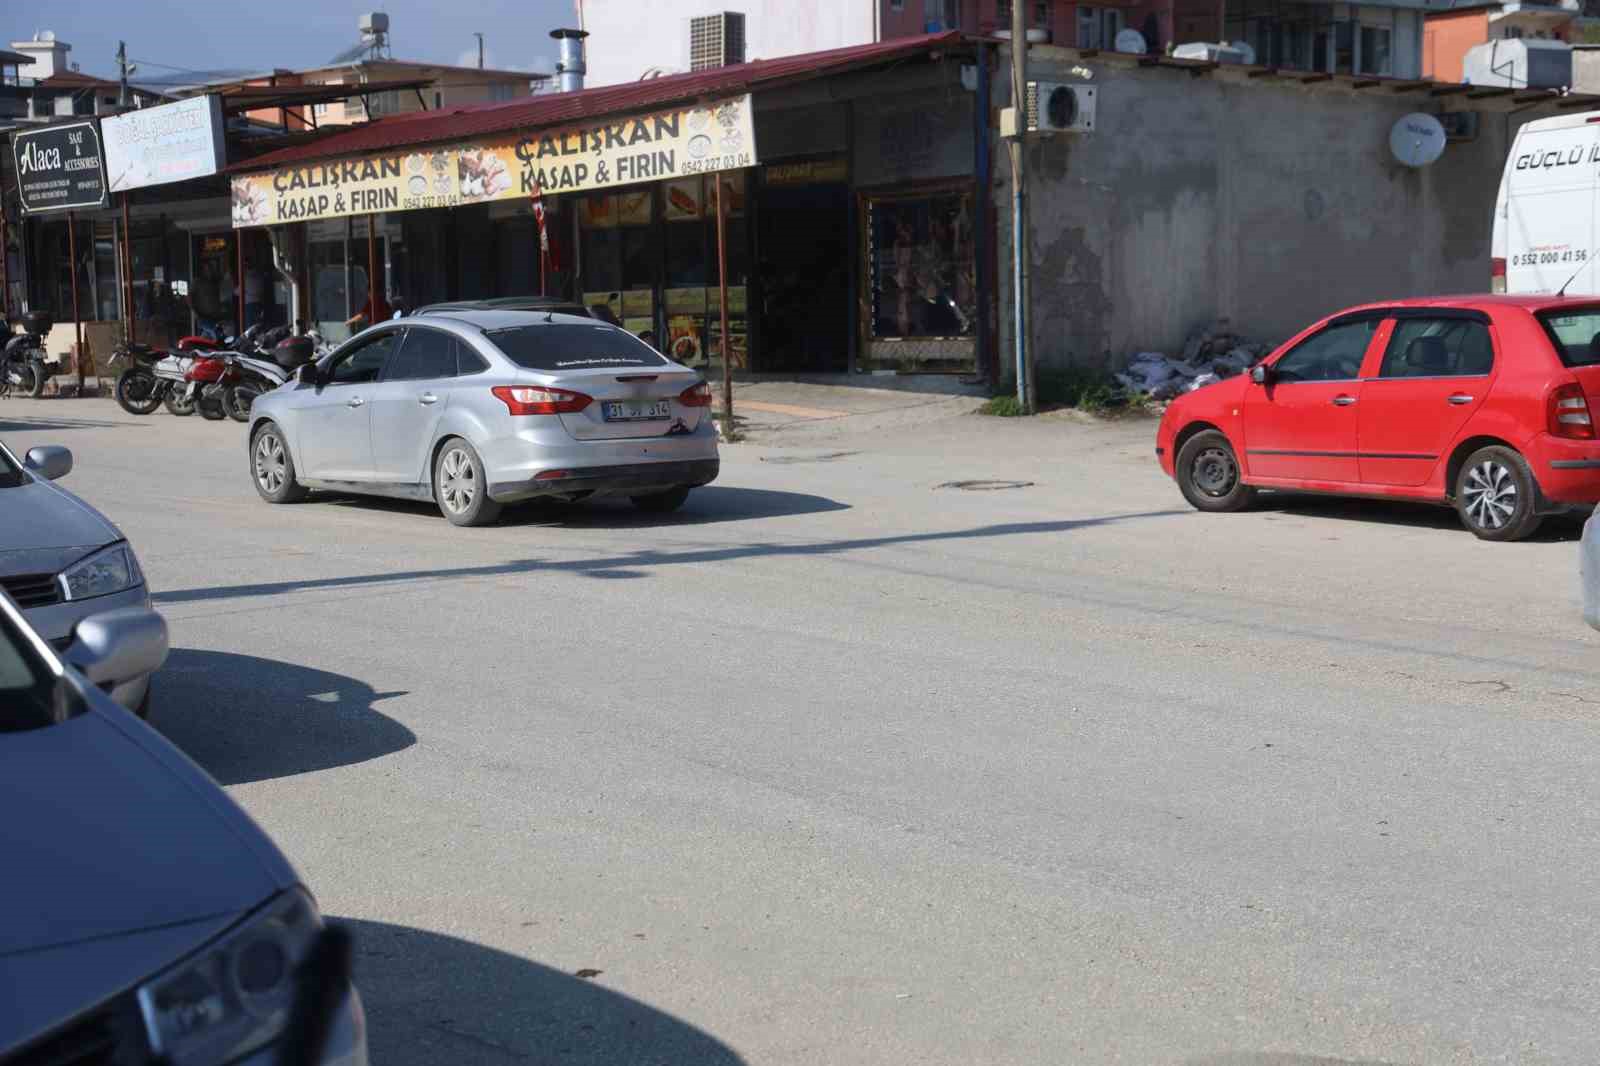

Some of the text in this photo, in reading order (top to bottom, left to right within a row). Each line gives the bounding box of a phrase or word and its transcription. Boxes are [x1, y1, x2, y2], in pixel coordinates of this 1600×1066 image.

[515, 112, 680, 167] ÇALIŞKAN
[20, 141, 61, 175] Alaca
[520, 149, 675, 193] KASAP & FIRIN
[723, 154, 736, 169] 03
[1516, 144, 1584, 170] GÜÇLÜ
[273, 158, 401, 197] ÇALIŞKAN
[277, 186, 398, 219] KASAP & FIRIN
[1512, 248, 1588, 266] 0 552 000 41 56
